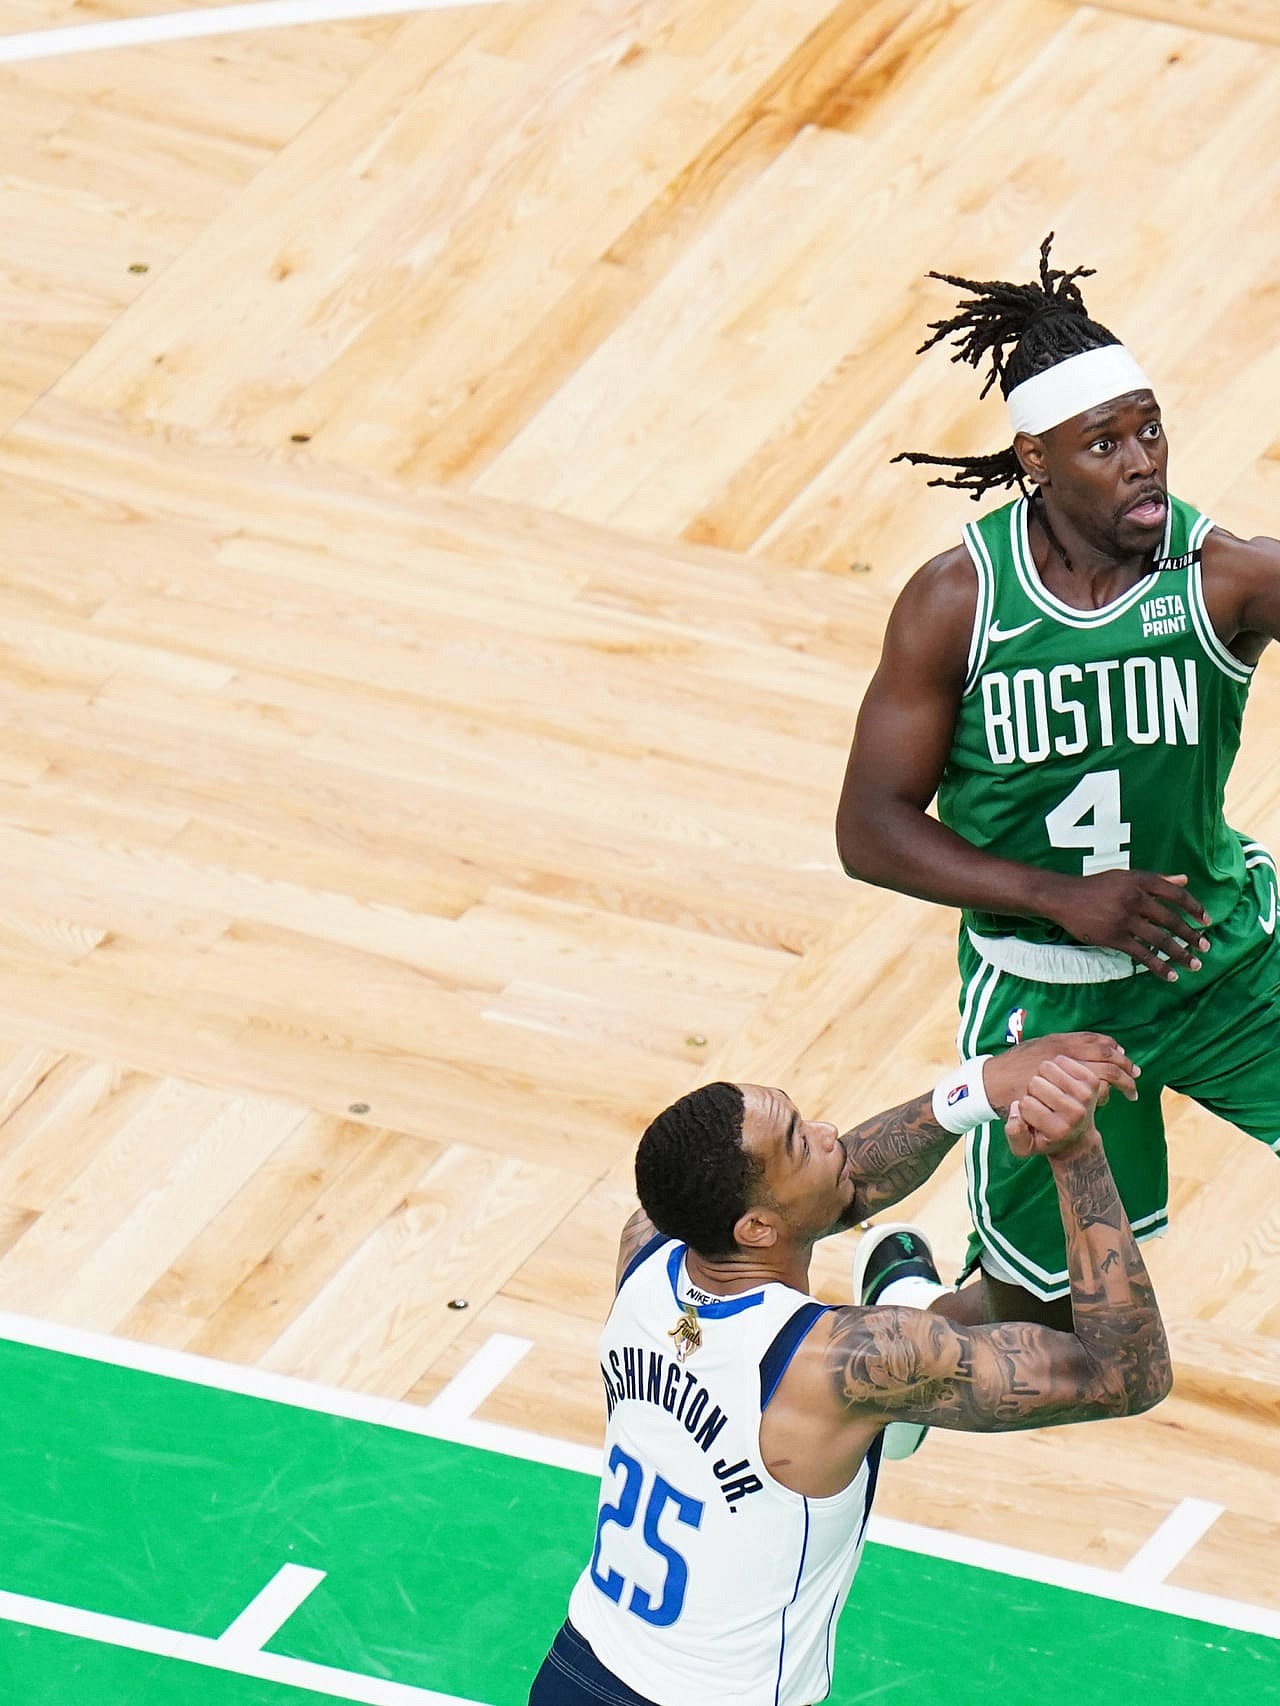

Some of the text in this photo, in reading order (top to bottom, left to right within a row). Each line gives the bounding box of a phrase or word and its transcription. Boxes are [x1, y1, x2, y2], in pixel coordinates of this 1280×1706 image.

[1158, 552, 1193, 570] WALTON
[1140, 594, 1186, 622] VISTA
[1142, 614, 1186, 638] PRINT
[980, 655, 1199, 764] BOSTON
[1045, 768, 1131, 877] 4
[686, 1287, 711, 1306] NIKE
[712, 1458, 764, 1513] JR.
[590, 1443, 706, 1629] 25
